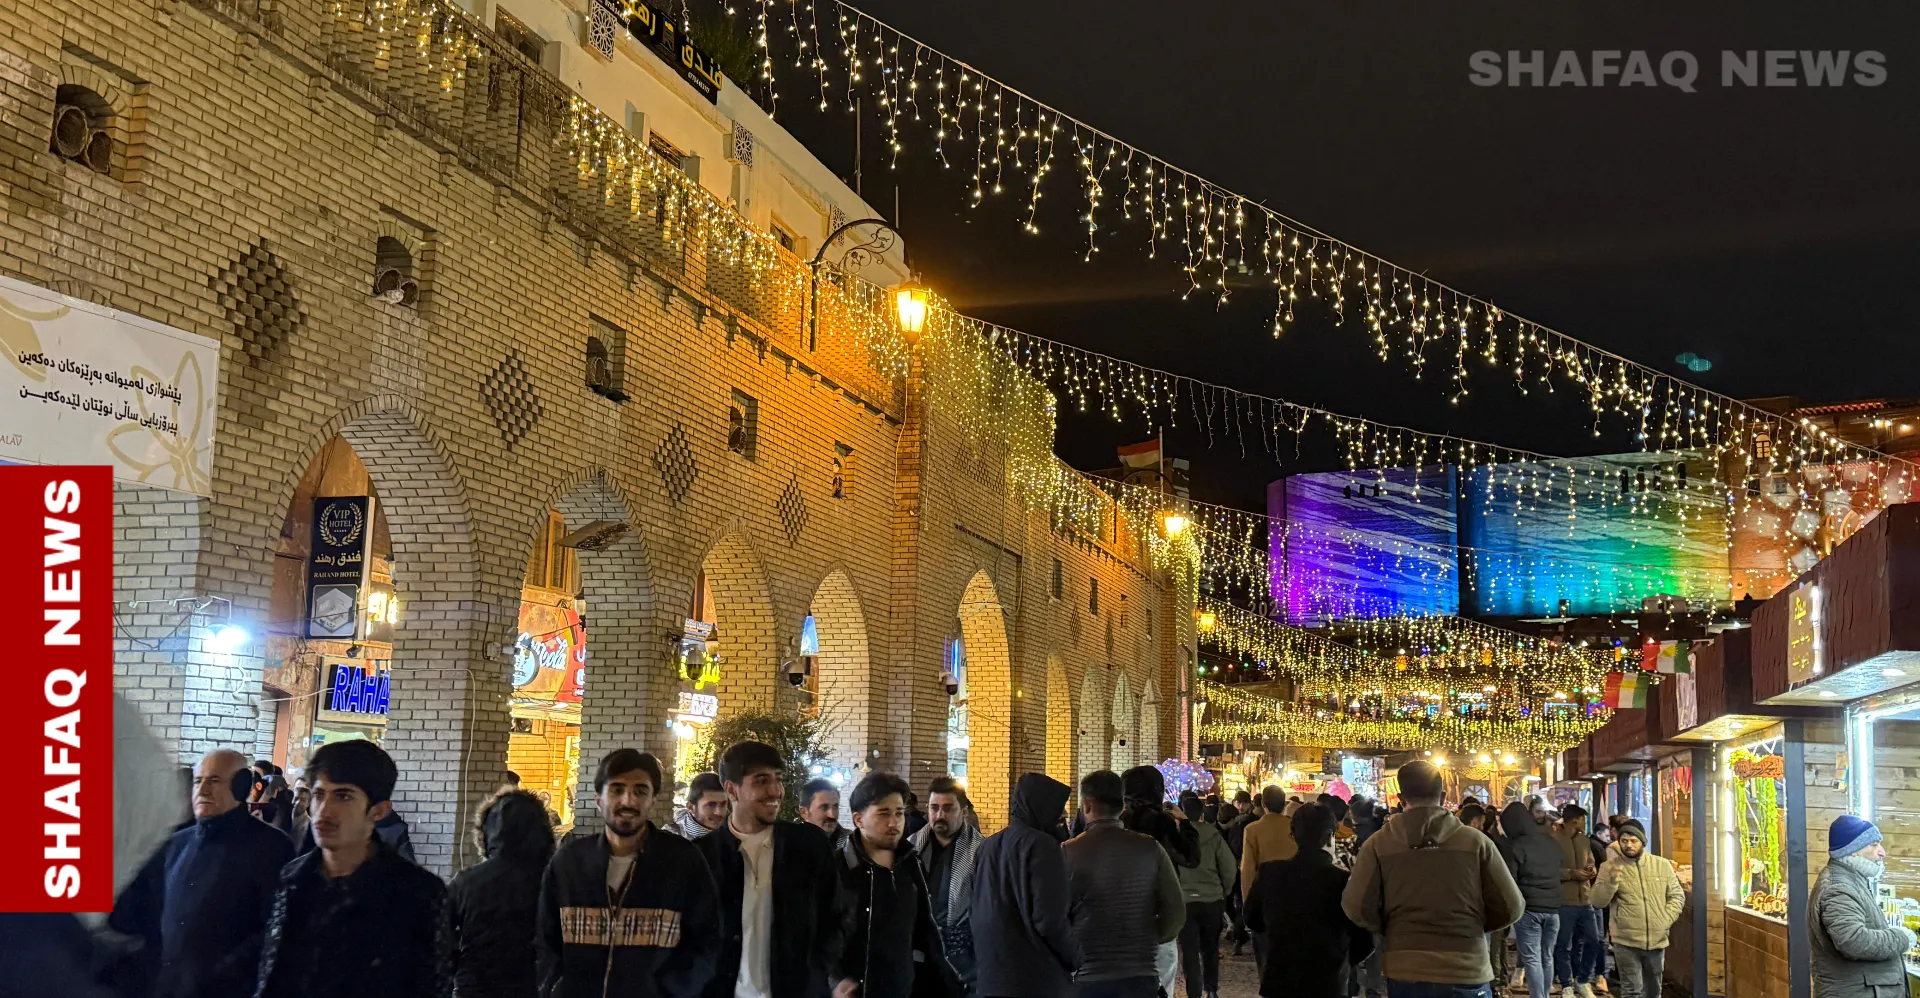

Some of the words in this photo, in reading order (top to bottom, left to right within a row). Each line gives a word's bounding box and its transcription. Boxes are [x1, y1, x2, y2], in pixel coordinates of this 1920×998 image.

[681, 34, 723, 91] فندق
[18, 350, 56, 368] دەکەین
[115, 400, 139, 421] ساڵی
[333, 509, 351, 519] VIP
[329, 520, 353, 528] HOTEL
[314, 553, 336, 567] رهند
[337, 550, 362, 567] فندق
